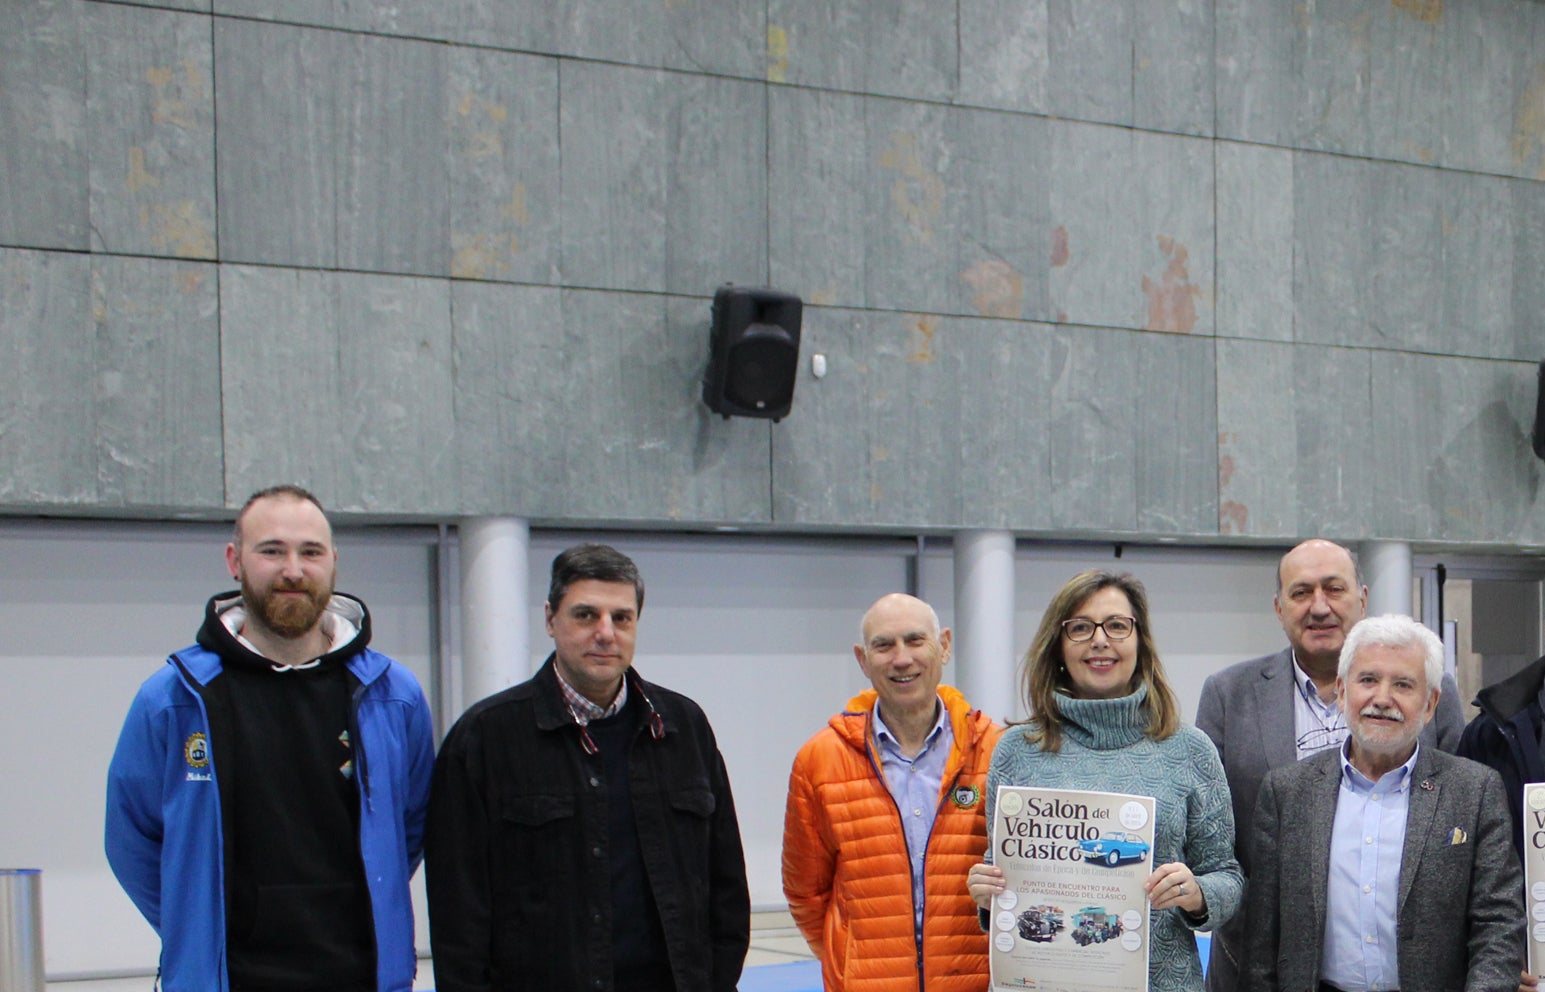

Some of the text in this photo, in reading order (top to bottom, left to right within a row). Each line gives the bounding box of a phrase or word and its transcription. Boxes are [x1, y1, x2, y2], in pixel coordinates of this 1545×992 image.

[1027, 798, 1088, 820] Salón
[1092, 808, 1110, 819] del
[1004, 817, 1100, 841] Vehículo
[1002, 838, 1082, 862] Clásico
[1022, 880, 1046, 888] PUNTO
[1058, 882, 1099, 892] ENCUENTRO
[1031, 888, 1080, 898] APASIONADOS
